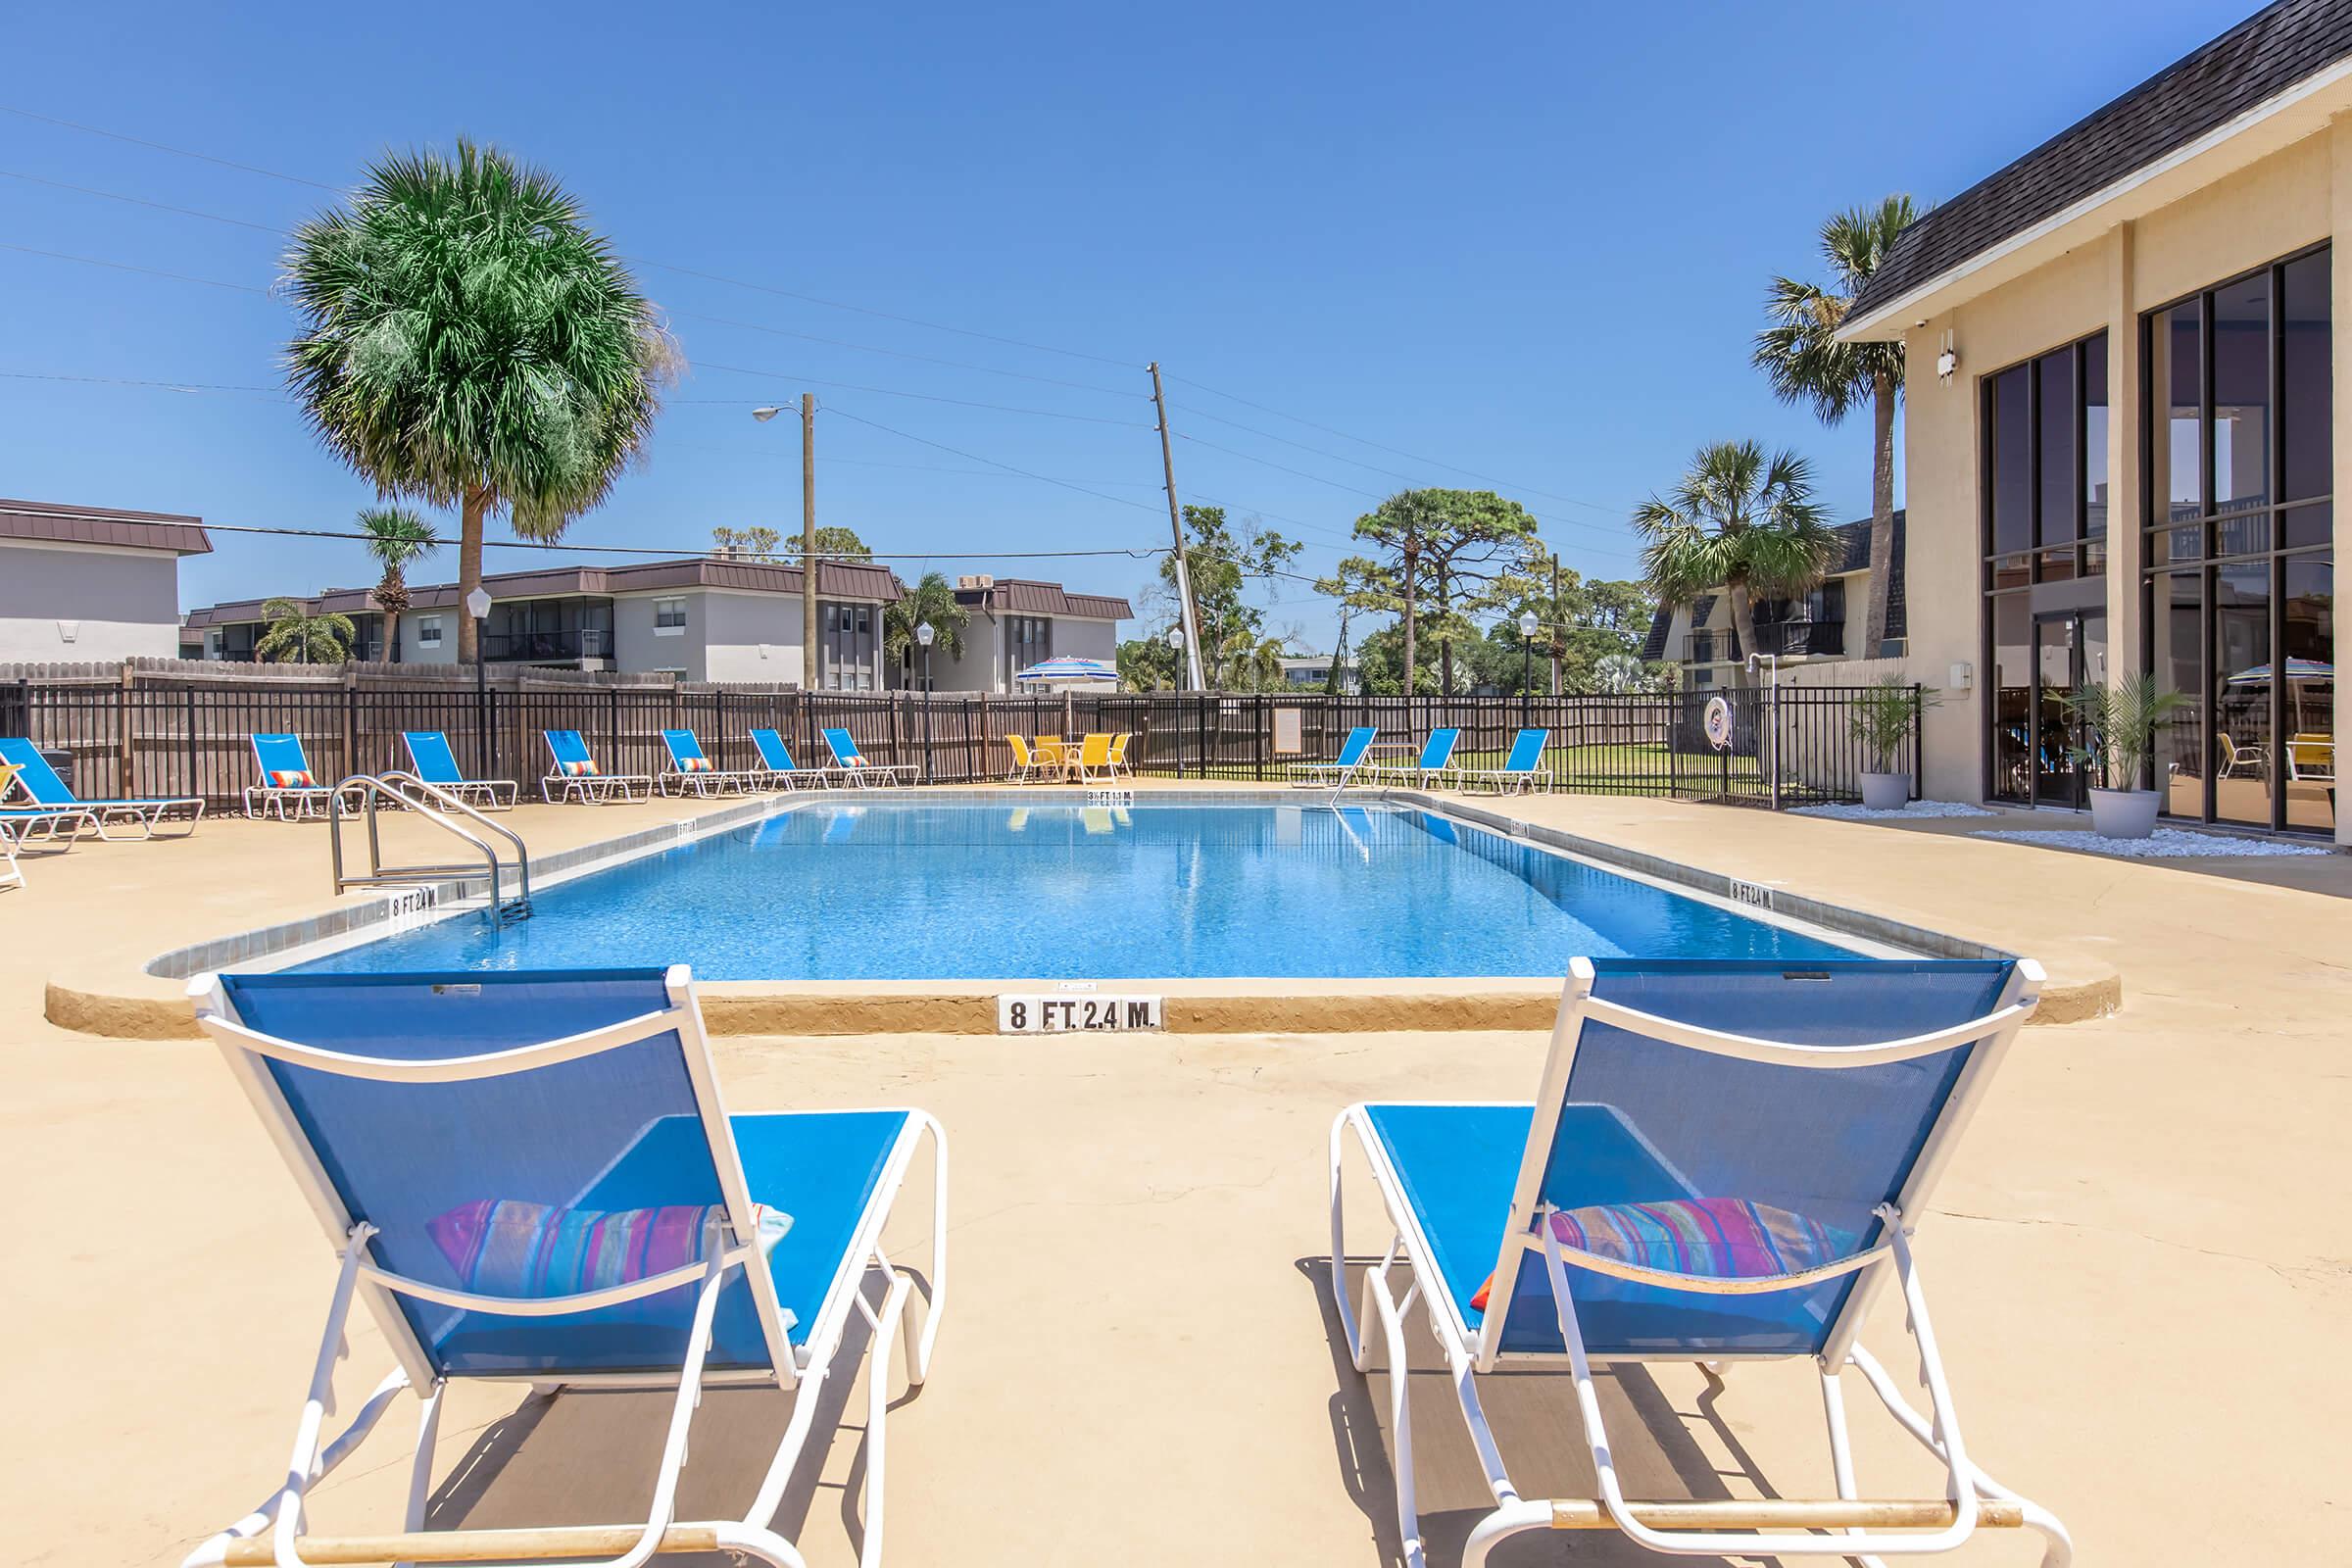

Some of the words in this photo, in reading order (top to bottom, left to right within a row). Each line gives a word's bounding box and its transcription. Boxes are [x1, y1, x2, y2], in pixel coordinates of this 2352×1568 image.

[1733, 882, 1738, 899] 8
[393, 899, 399, 916] 8
[1010, 1002, 1027, 1029] 8
[1042, 1002, 1077, 1029] FT.
[1084, 1001, 1117, 1029] 2.4
[1128, 1002, 1155, 1028] M.
